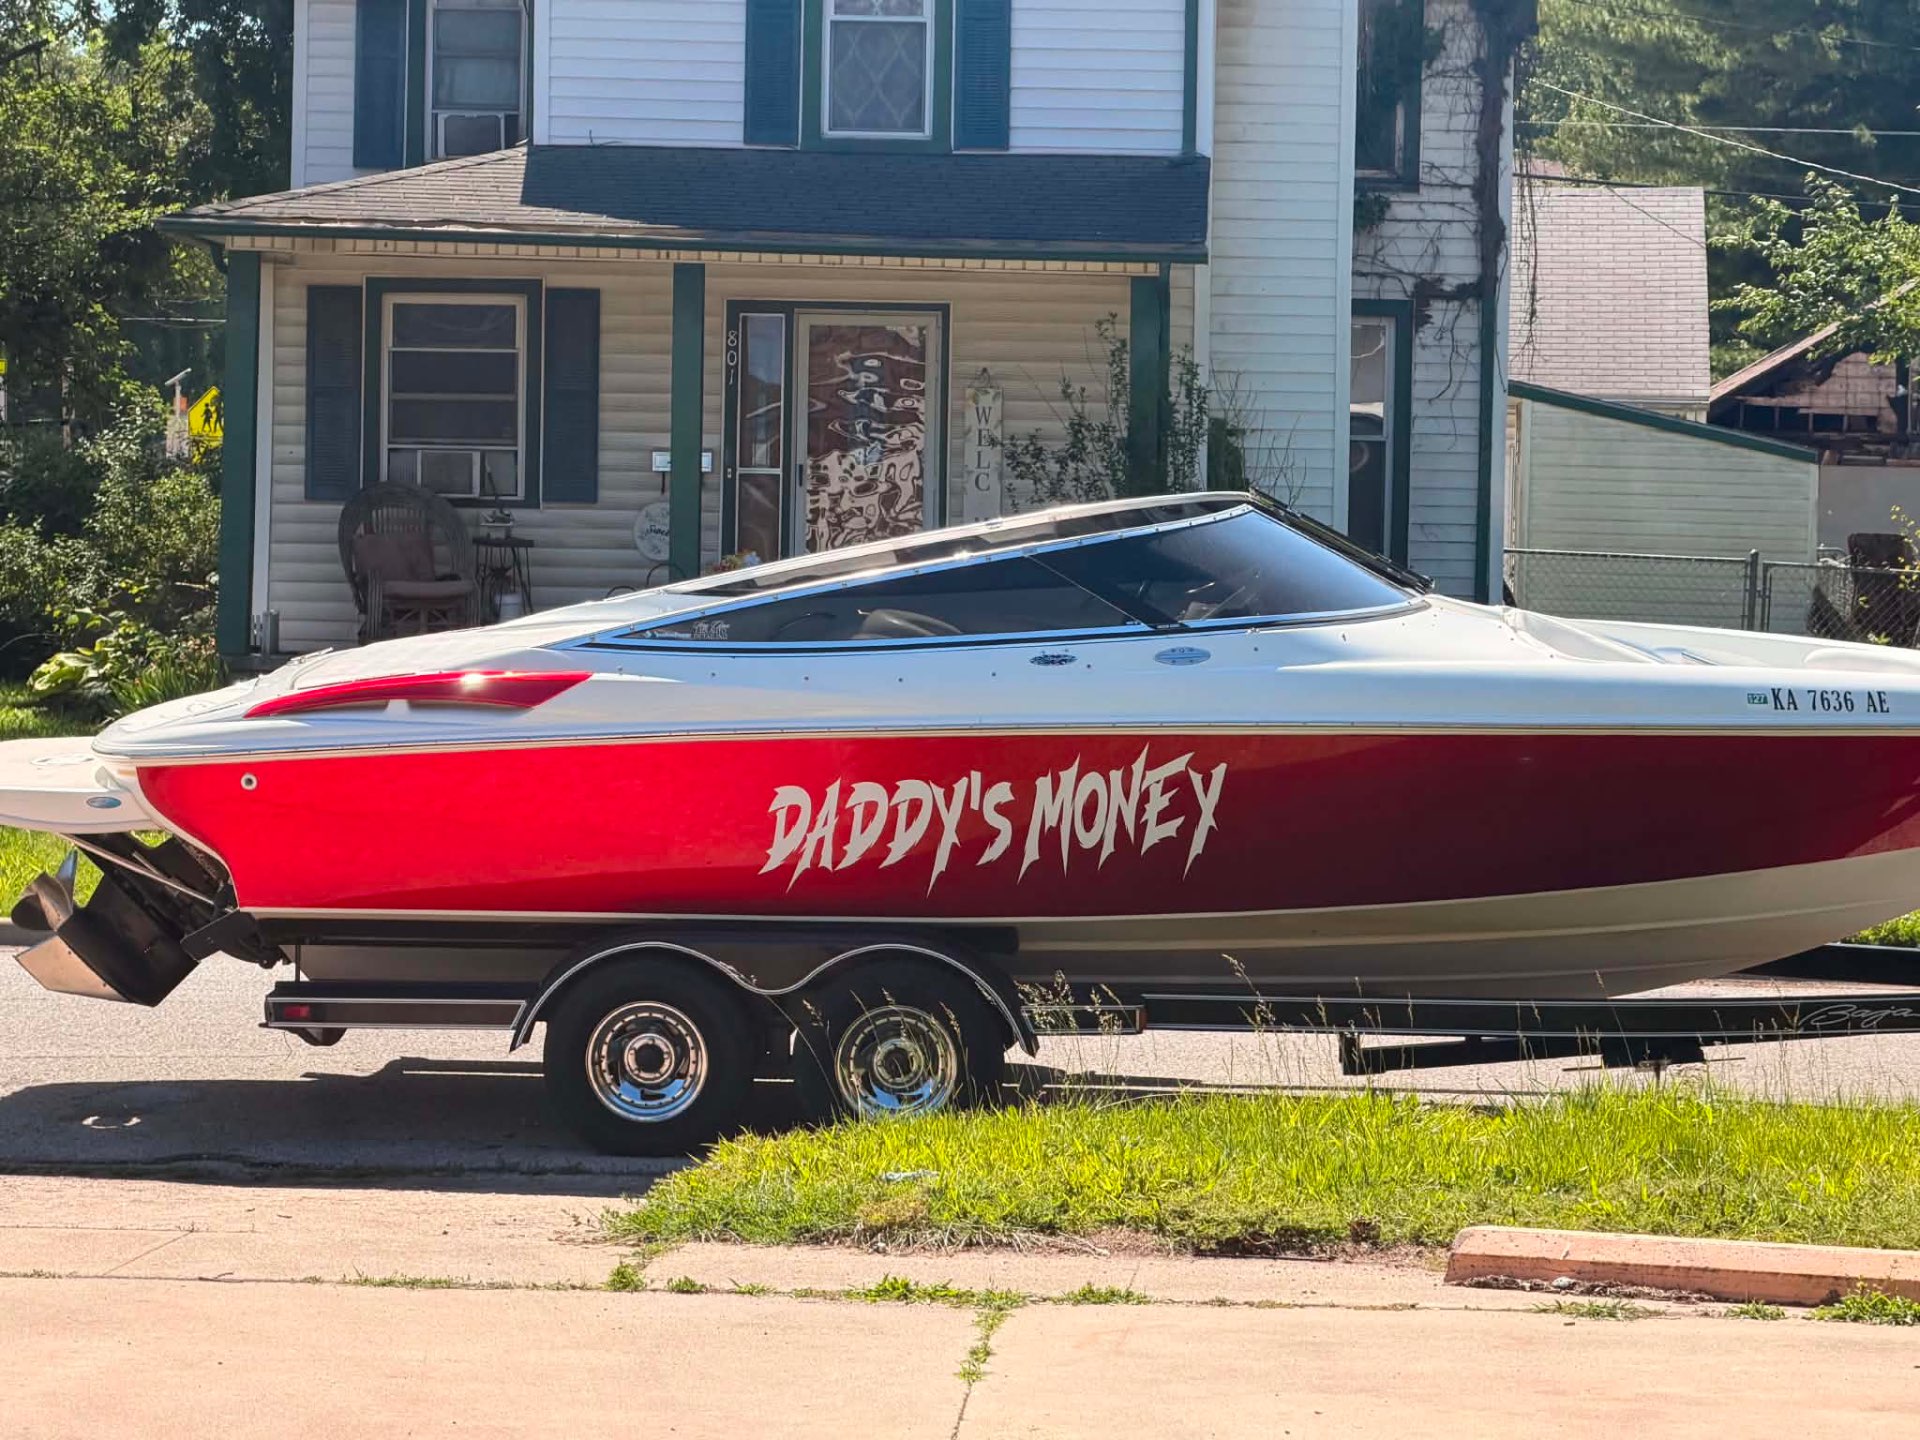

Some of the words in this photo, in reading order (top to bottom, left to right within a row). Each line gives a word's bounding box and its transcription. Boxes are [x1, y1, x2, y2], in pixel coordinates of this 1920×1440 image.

[727, 330, 738, 385] 801
[974, 405, 993, 522] WELC
[1771, 688, 1799, 711] KA
[1807, 690, 1855, 712] 7636
[1867, 691, 1890, 713] AE
[758, 770, 1015, 898] DADDY'S
[1017, 742, 1227, 885] MONEY
